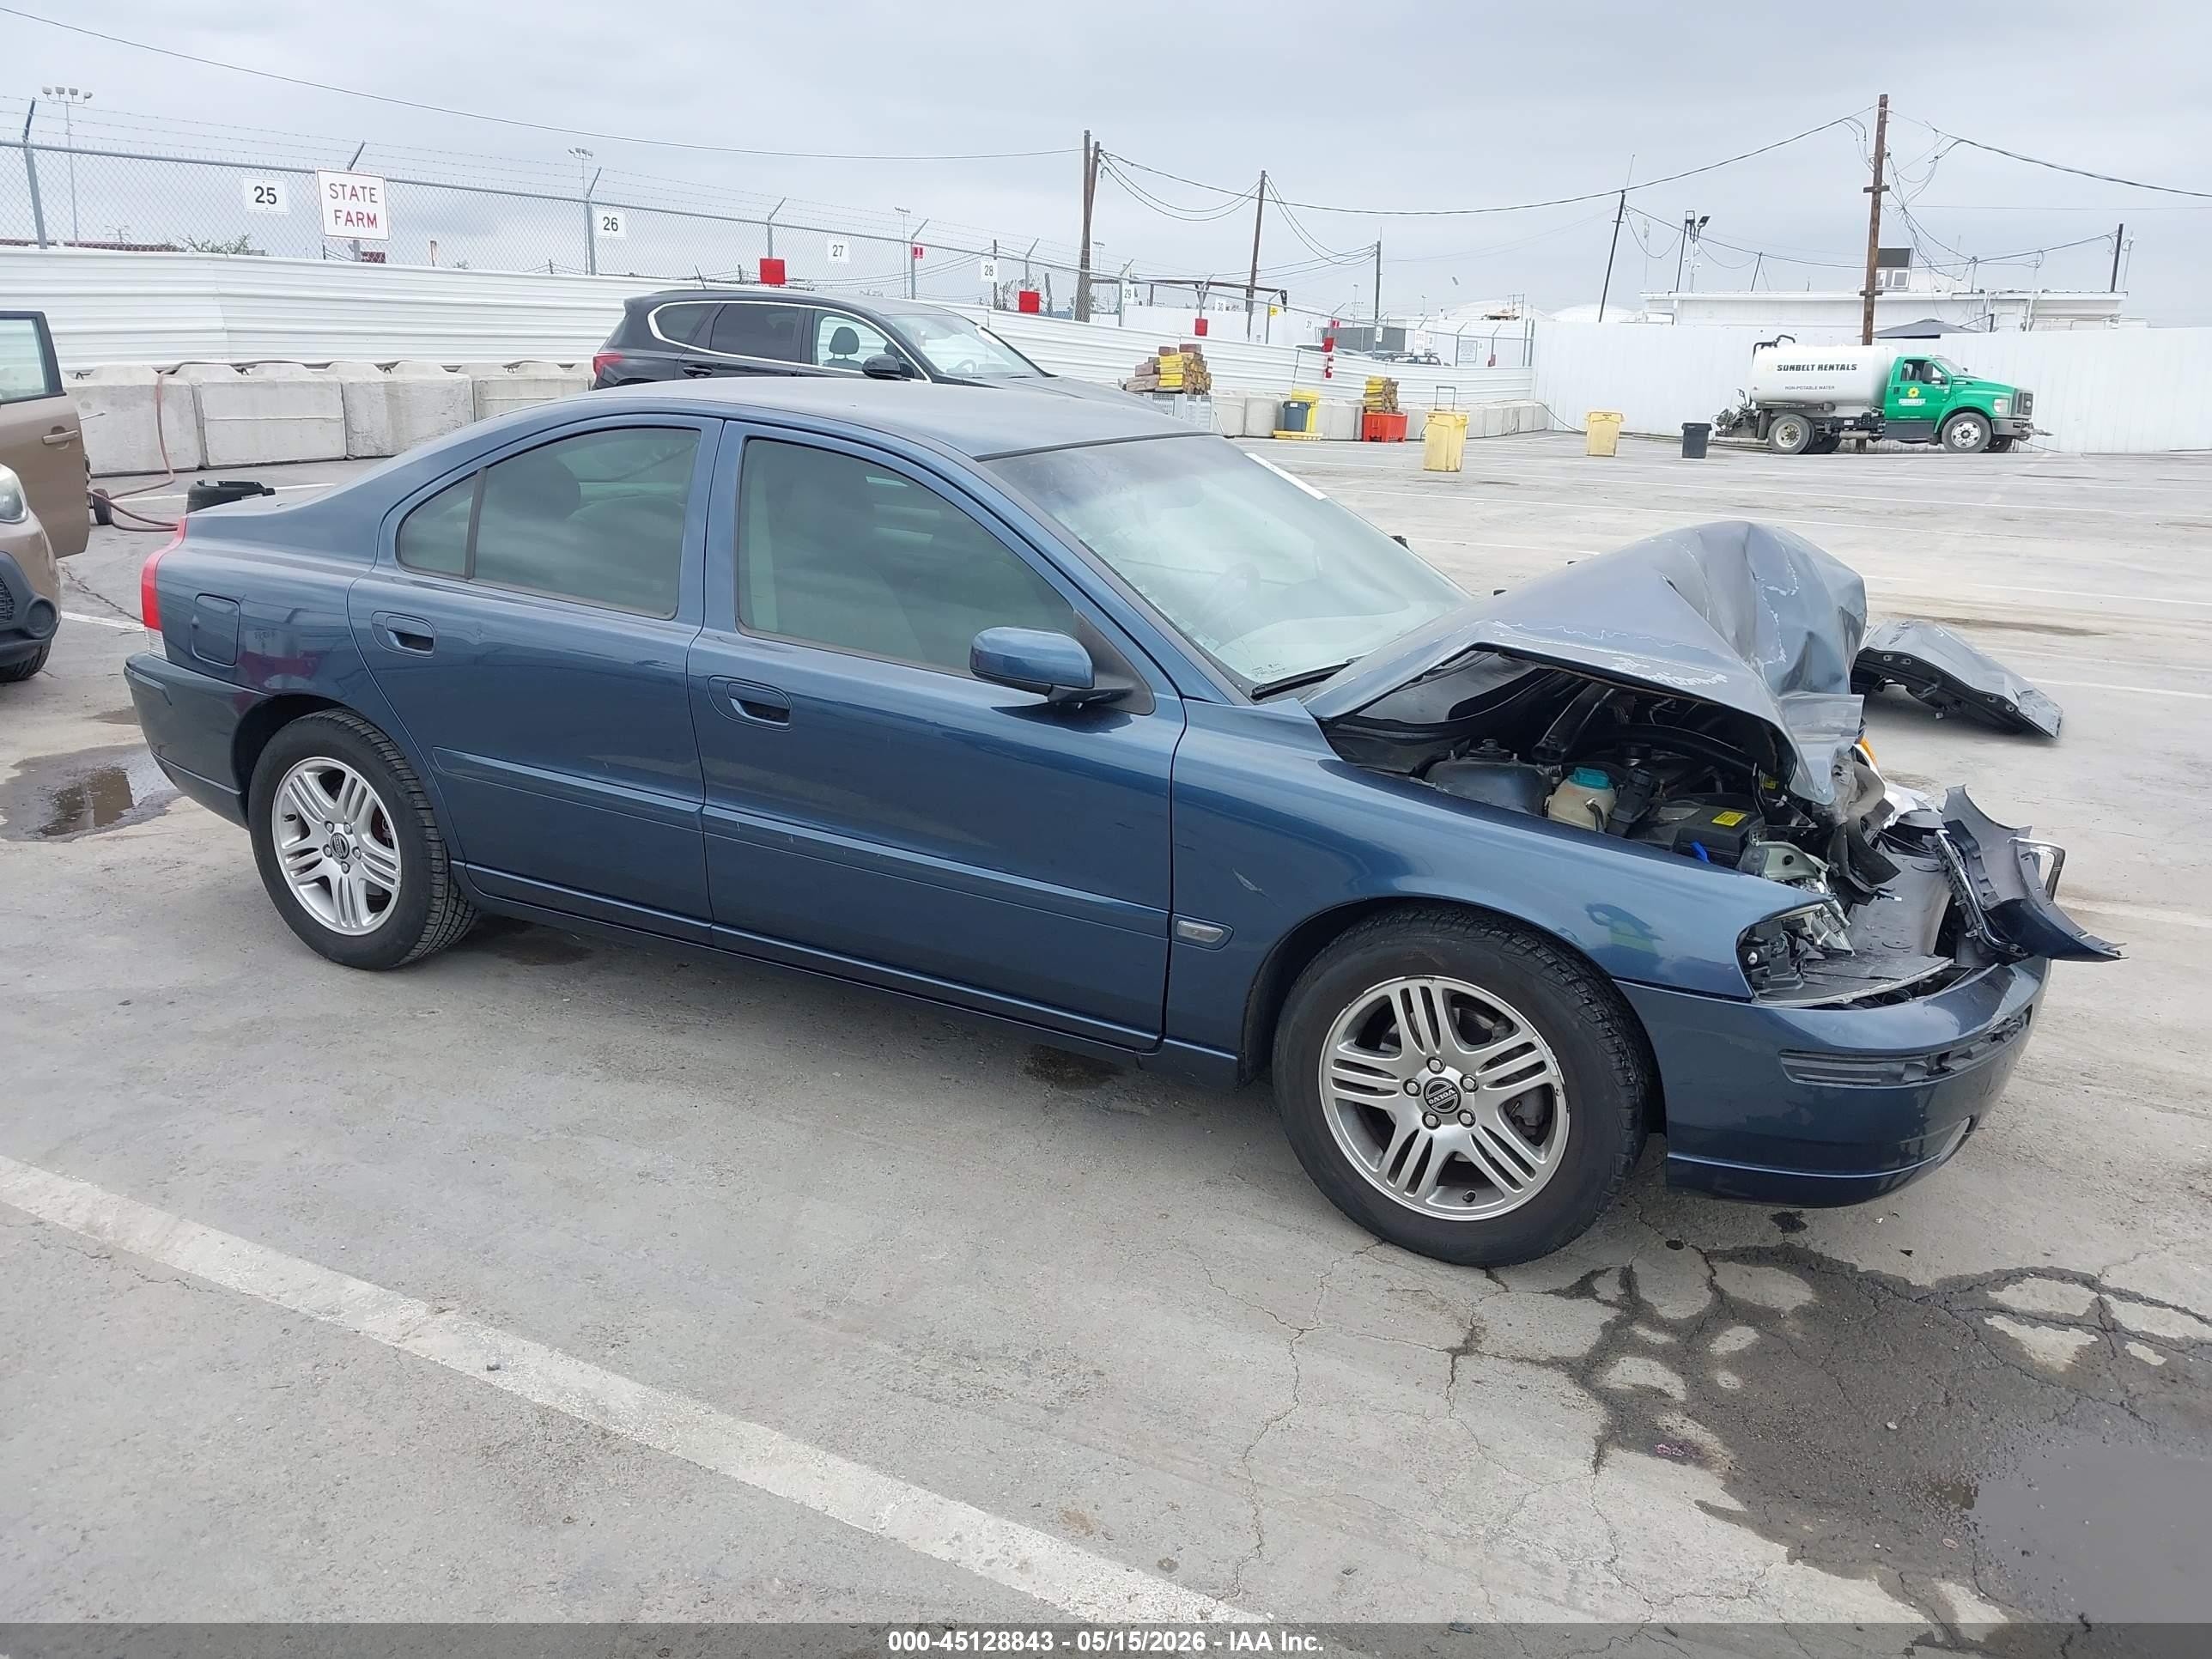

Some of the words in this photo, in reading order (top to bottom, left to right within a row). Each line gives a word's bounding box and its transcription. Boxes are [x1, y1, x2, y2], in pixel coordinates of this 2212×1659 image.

[253, 185, 277, 205] 25
[329, 183, 378, 204] STATE
[333, 209, 378, 229] FARM
[603, 216, 619, 232] 26
[832, 244, 844, 258] 27
[984, 264, 994, 276] 28
[1124, 288, 1132, 300] 29
[1428, 1089, 1456, 1105] VOLVO
